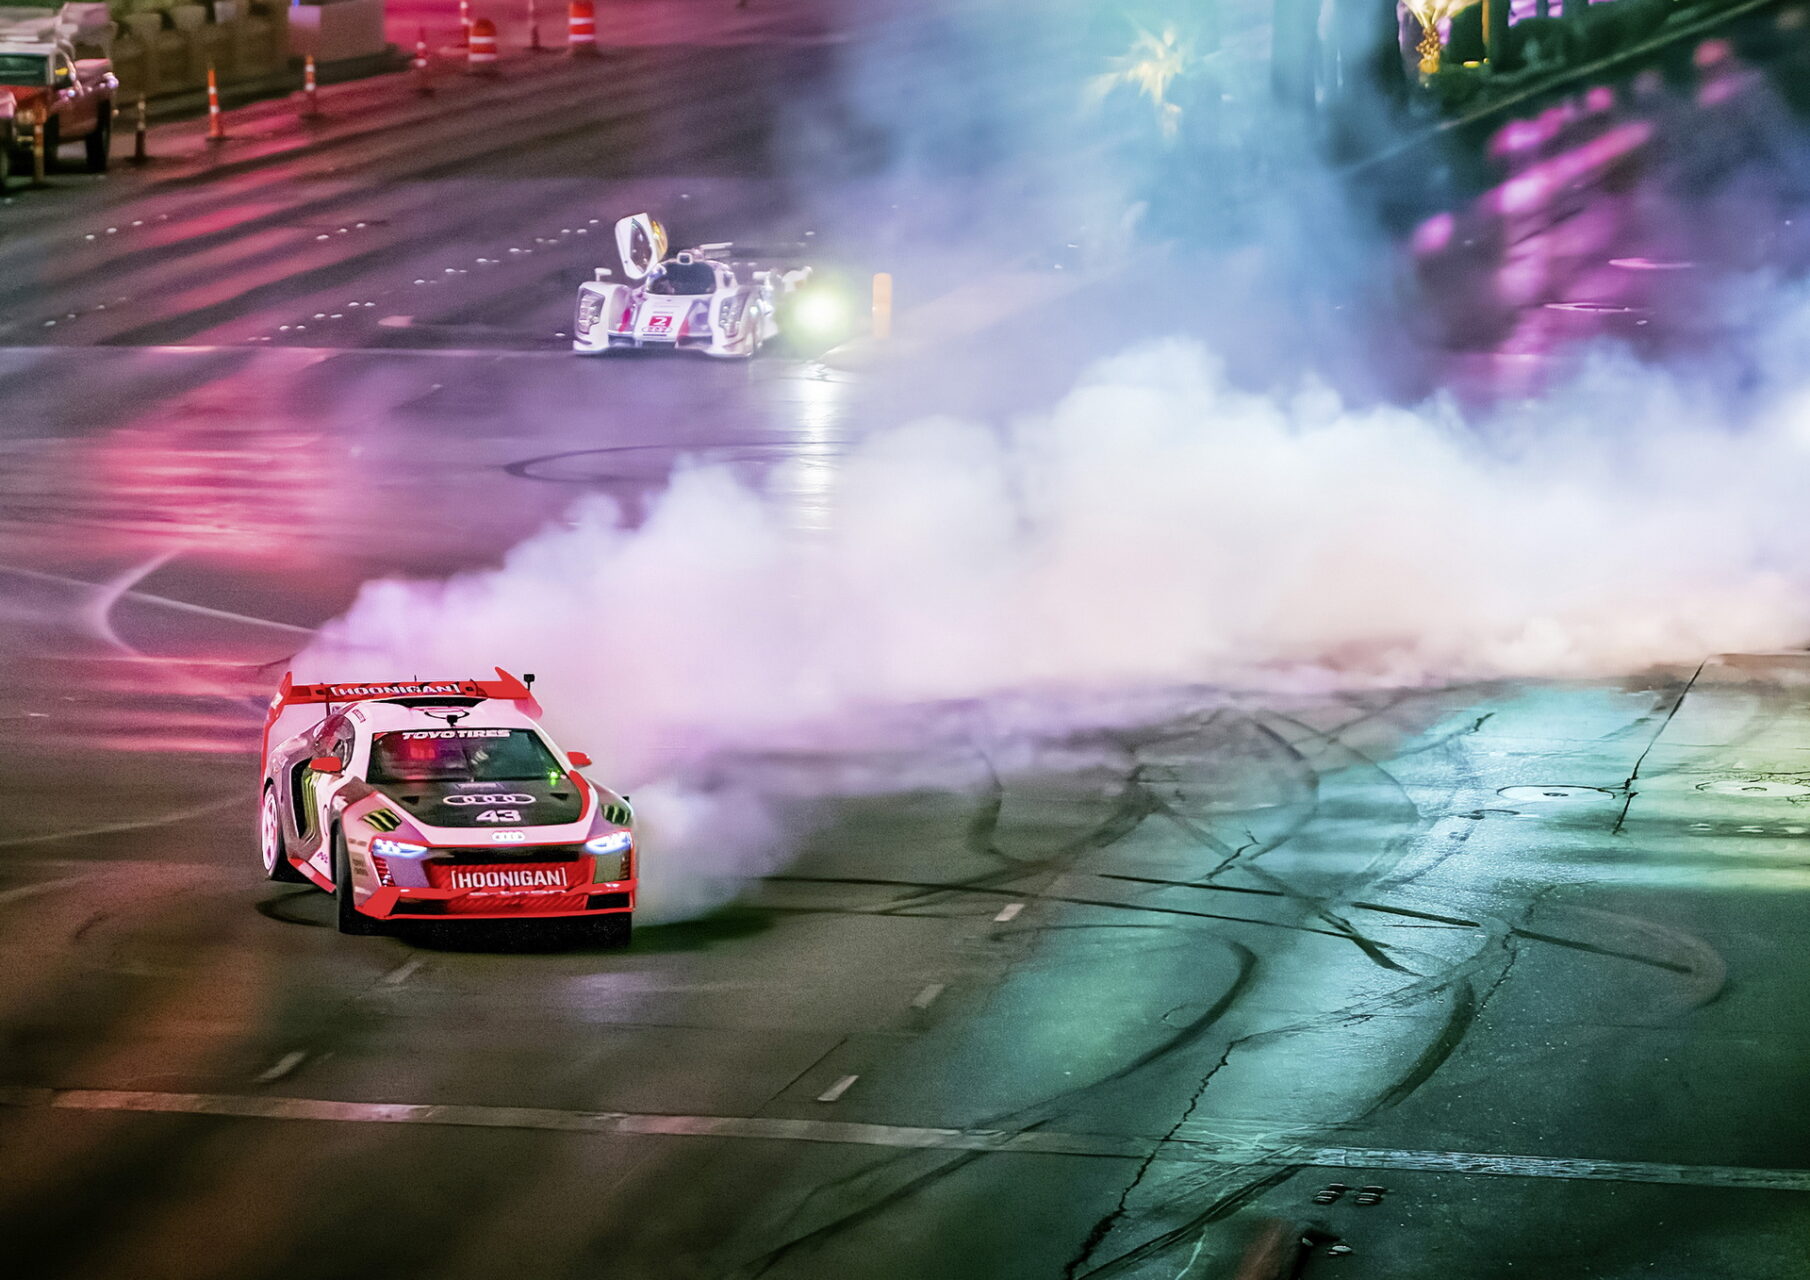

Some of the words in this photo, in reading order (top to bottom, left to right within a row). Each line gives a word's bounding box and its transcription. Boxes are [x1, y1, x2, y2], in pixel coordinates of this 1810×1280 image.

[654, 316, 668, 326] 2
[402, 731, 455, 740] TOYO
[457, 729, 511, 738] TIRES
[476, 810, 521, 823] 43
